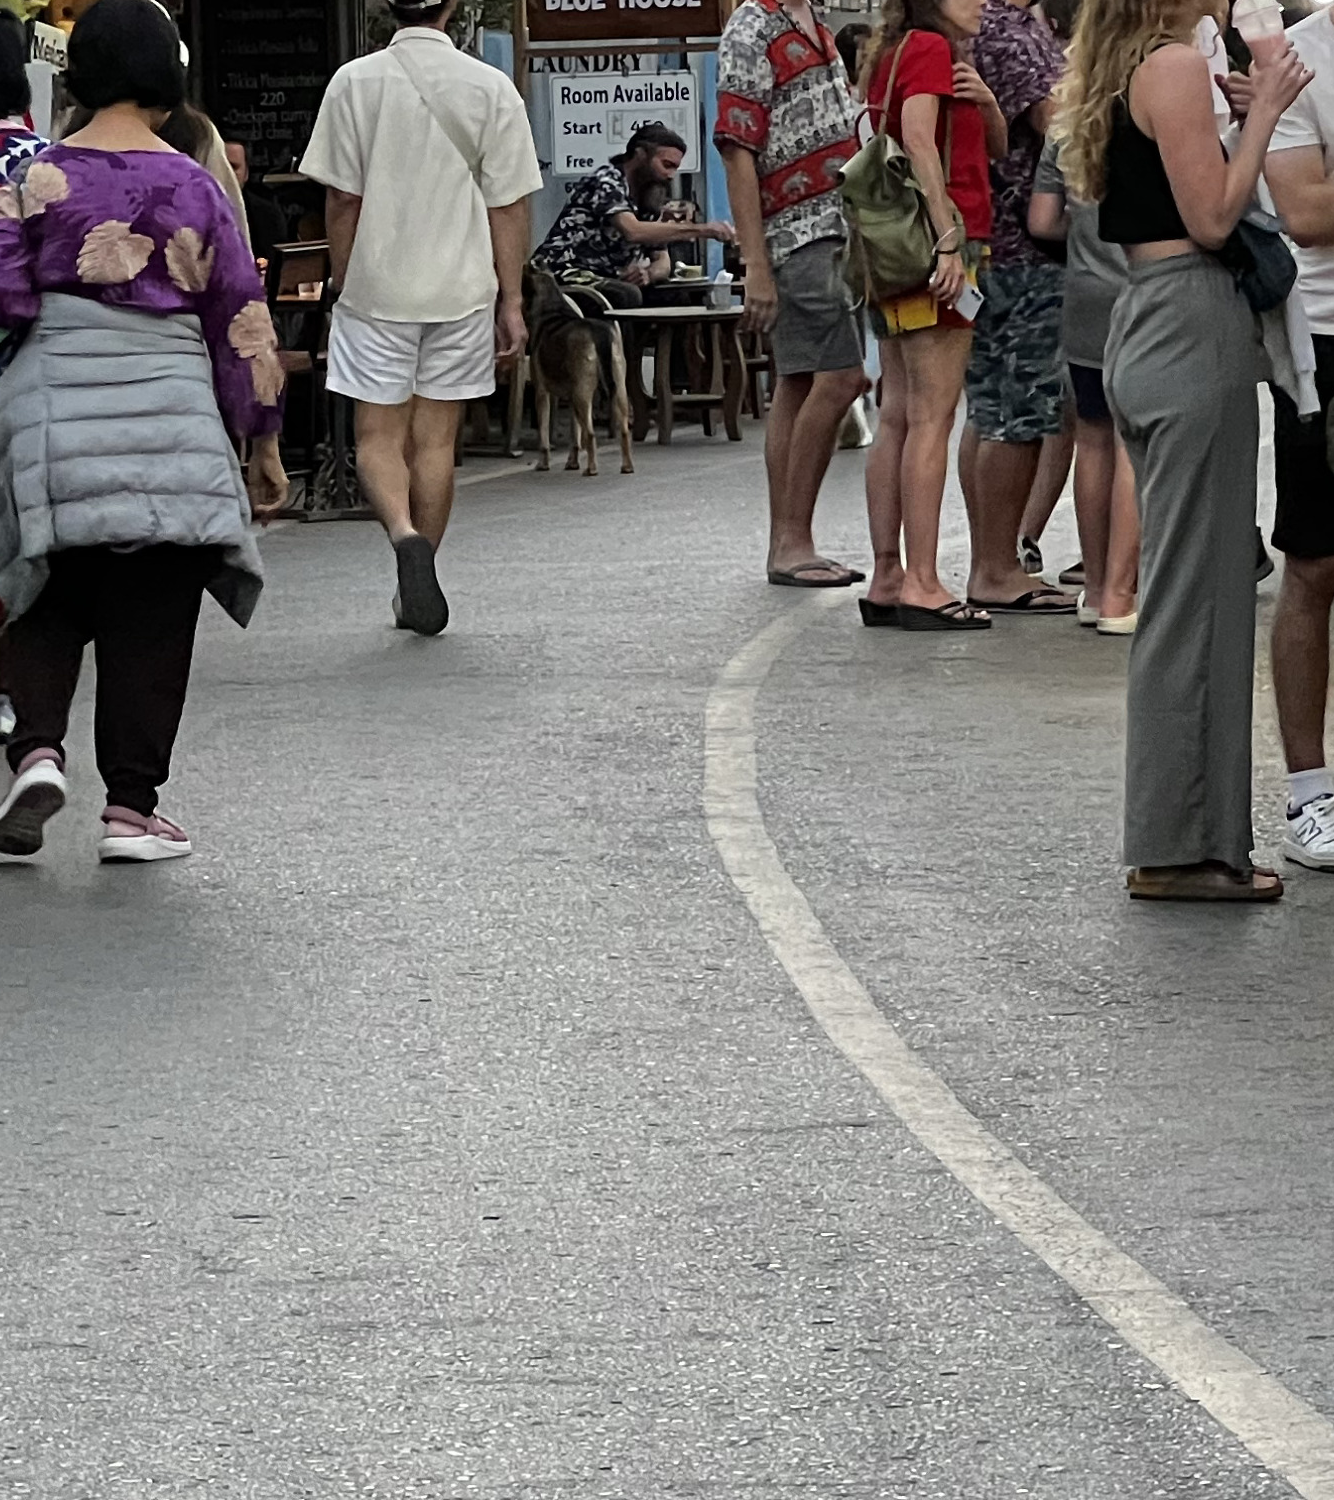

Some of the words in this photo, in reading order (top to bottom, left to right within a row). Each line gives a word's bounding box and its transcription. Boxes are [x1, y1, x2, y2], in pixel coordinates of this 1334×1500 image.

[528, 53, 642, 74] LAUNDRY
[561, 86, 609, 104] Room
[613, 81, 690, 103] Available
[563, 121, 602, 135] Start
[566, 155, 594, 168] Free
